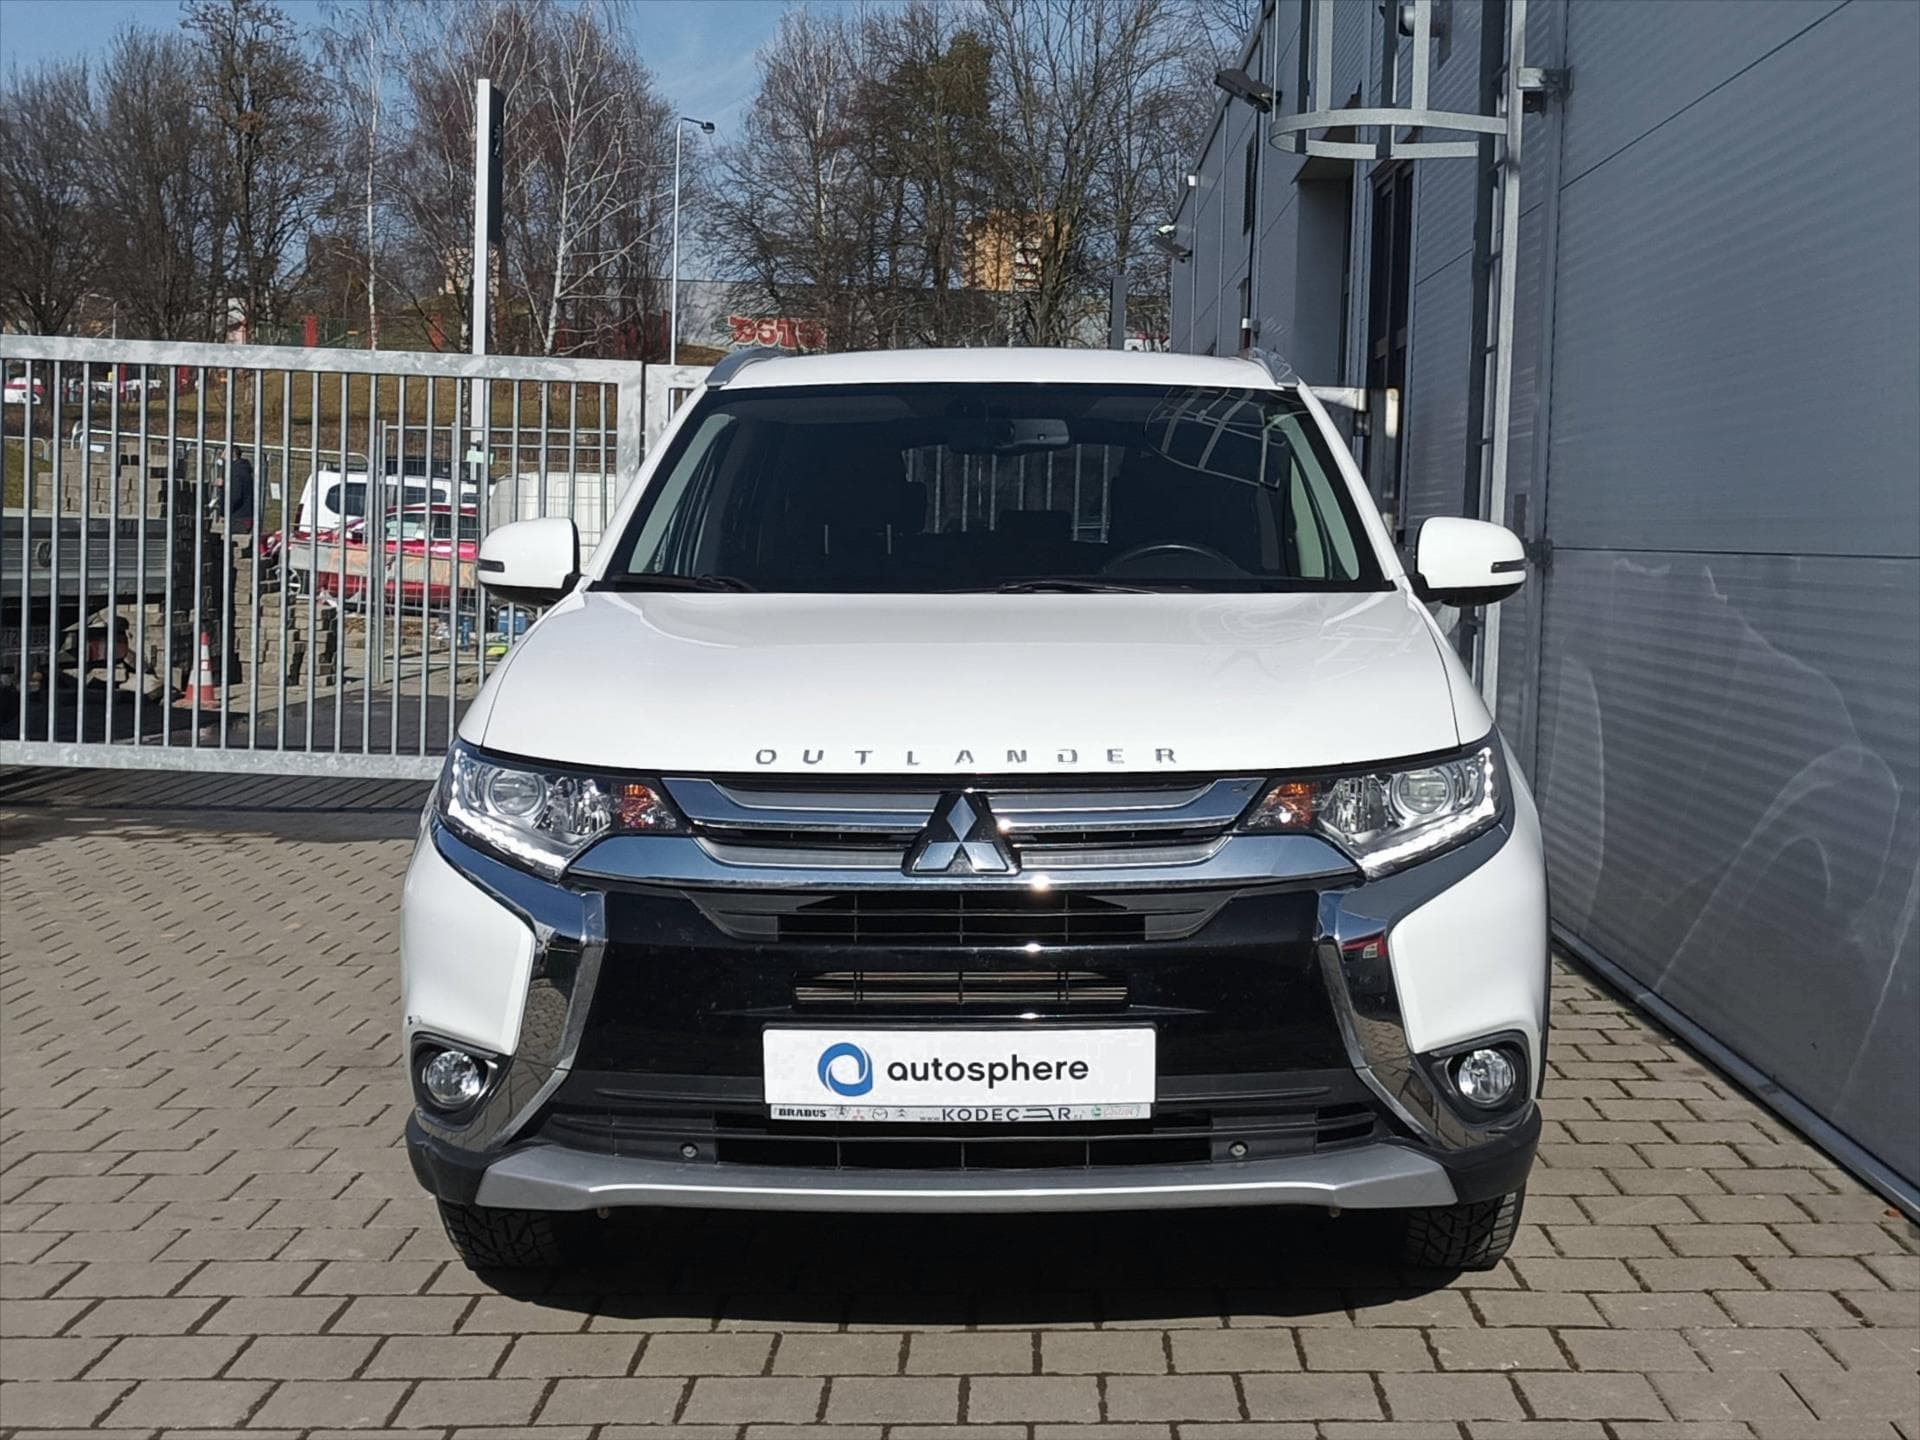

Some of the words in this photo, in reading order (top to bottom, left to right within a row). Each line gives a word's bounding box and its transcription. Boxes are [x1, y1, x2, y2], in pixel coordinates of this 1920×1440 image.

[755, 748, 1176, 766] OUTLANDER
[886, 1053, 1089, 1089] autosphere
[778, 1107, 827, 1118] BRABUS
